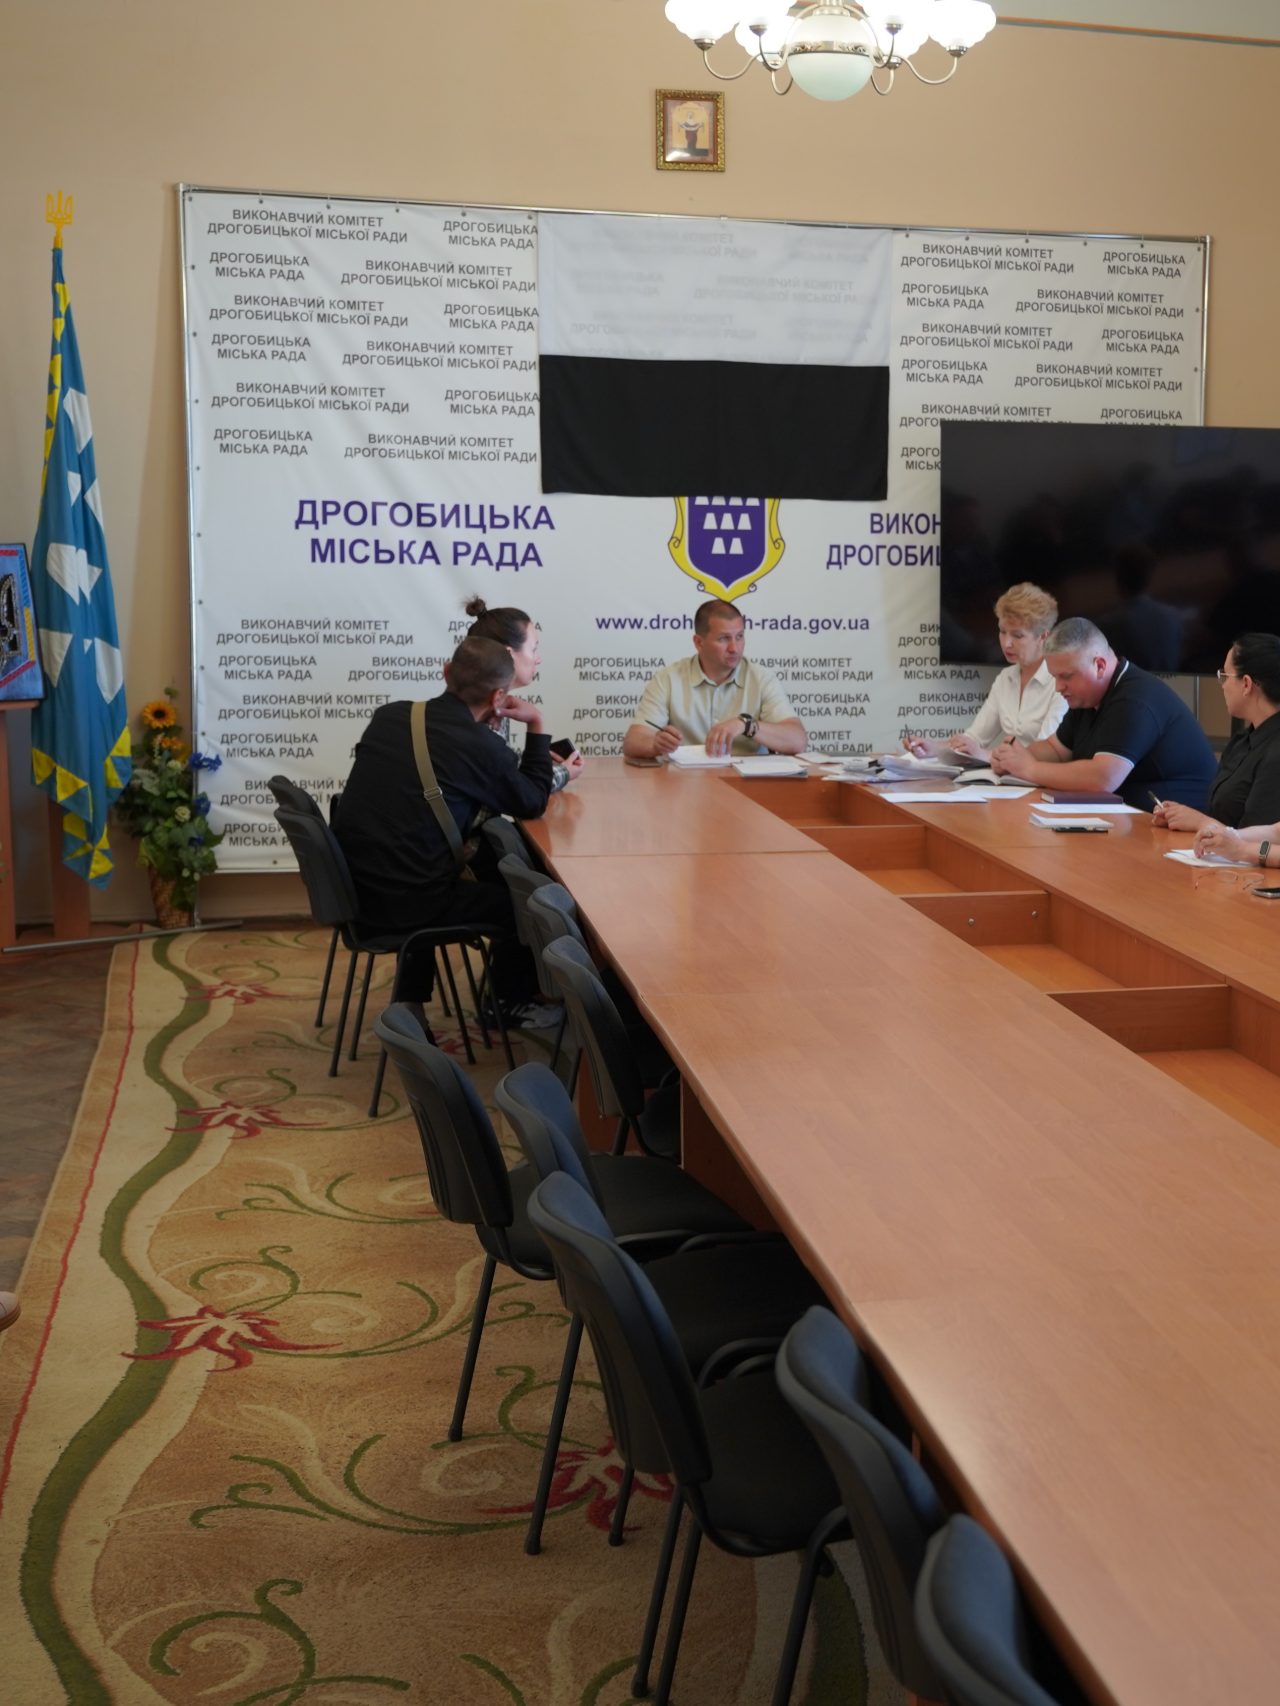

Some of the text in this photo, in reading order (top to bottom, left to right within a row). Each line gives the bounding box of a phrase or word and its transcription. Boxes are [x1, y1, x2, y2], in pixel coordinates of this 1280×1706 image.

[232, 209, 383, 228] ВИКОНАВЧИЙ КОМІТЕТ
[207, 222, 407, 244] ДРОГОБИЦЬКОЇ МІСЬКОЇ РАДИ
[443, 220, 539, 235] ДРОГОБИЦЬКА
[448, 235, 534, 249] МІСЬКА РАДА
[922, 243, 1053, 259] ВИКОНАВЧИЙ КОМІТЕТ
[1102, 251, 1186, 265] ДРОГОБИЦЬКА
[209, 252, 310, 266] ДРОГОБИЦЬКА
[900, 256, 1074, 275] ДРОГОБИЦЬКОЇ МІСЬКОЇ РАДИ
[215, 266, 305, 281] МІСЬКА РАДА
[365, 260, 512, 277] ВИКОНАВЧИЙ КОМІТЕТ
[1107, 264, 1182, 279] МІСЬКА РАДА
[340, 273, 536, 292] ДРОГОБИЦЬКОЇ МІСЬКОЇ РАДИ
[901, 283, 989, 297] ДРОГОБИЦЬКА
[1037, 289, 1164, 304] ВИКОНАВЧИЙ КОМІТЕТ
[234, 295, 384, 311] ВИКОНАВЧИЙ КОМІТЕТ
[907, 296, 984, 310] МІСЬКА РАДА
[1015, 301, 1184, 319] ДРОГОБИЦЬКОЇ МІСЬКОЇ РАДИ
[443, 303, 540, 318] ДРОГОБИЦЬКА
[209, 308, 408, 328] ДРОГОБИЦЬКОЇ МІСЬКОЇ РАДИ
[449, 318, 535, 332] МІСЬКА РАДА
[922, 323, 1053, 338] ВИКОНАВЧИЙ КОМІТЕТ
[1101, 329, 1184, 342] ДРОГОБИЦЬКА
[211, 334, 311, 347] ДРОГОБИЦЬКА
[899, 335, 1073, 353] ДРОГОБИЦЬКОЇ МІСЬКОЇ РАДИ
[217, 348, 306, 362] МІСЬКА РАДА
[366, 340, 513, 357] ВИКОНАВЧИЙ КОМІТЕТ
[1106, 342, 1180, 355] МІСЬКА РАДА
[342, 353, 537, 372] ДРОГОБИЦЬКОЇ МІСЬКОЇ РАДИ
[901, 359, 988, 372] ДРОГОБИЦЬКА
[1036, 363, 1163, 378] ВИКОНАВЧИЙ КОМІТЕТ
[906, 372, 984, 385] МІСЬКА РАДА
[1014, 376, 1183, 392] ДРОГОБИЦЬКОЇ МІСЬКОЇ РАДИ
[236, 382, 385, 398] ВИКОНАВЧИЙ КОМІТЕТ
[444, 389, 541, 402] ДРОГОБИЦЬКА
[211, 396, 409, 414] ДРОГОБИЦЬКОЇ МІСЬКОЇ РАДИ
[450, 403, 535, 417] МІСЬКА РАДА
[921, 404, 1052, 417] ВИКОНАВЧИЙ КОМІТЕТ
[1100, 408, 1183, 421] ДРОГОБИЦЬКА
[213, 428, 313, 442] ДРОГОБИЦЬКА
[368, 433, 514, 449] ВИКОНАВЧИЙ КОМІТЕТ
[219, 443, 308, 457] МІСЬКА РАДА
[344, 447, 537, 464] ДРОГОБИЦЬКОЇ МІСЬКОЇ РАДИ
[905, 460, 942, 471] МІСЬК
[295, 500, 555, 532] ДРОГОБИЦЬКА
[869, 512, 942, 535] ВИКОН
[310, 537, 544, 573] МІСЬКА РАДА
[826, 543, 942, 571] ДРОГОБИ
[241, 618, 390, 631] ВИКОНАВЧИЙ КОМІТЕТ
[595, 613, 870, 635] www.drohh-rada.gov.ua
[216, 633, 414, 647] ДРОГОБИЦЬКОЇ МІСЬКОЇ РАДИ
[218, 655, 317, 667] ДРОГОБИЦЬКА
[573, 657, 666, 669] ДРОГОБИЦЬКА
[802, 658, 853, 669] КОМІТЕТ
[224, 669, 313, 682] МІСЬКА РАДА
[348, 670, 446, 683] ДРОГОБИЦЬКО
[579, 670, 654, 683] МІСЬКА РАД
[791, 670, 839, 682] МІСЬКОЇ
[842, 671, 874, 683] РАДИ
[904, 669, 981, 682] МІСЬКА РАДА
[242, 693, 391, 706] ВИКОНАВЧИЙ КОМІТЕТ
[218, 707, 374, 721] ДРОГОБИЦЬКОЇ МІСЬКО
[794, 706, 867, 717] ІСЬКА РАДА
[220, 733, 319, 745] ДРОГОБИЦЬКА
[574, 732, 625, 744] ДРОГОБ
[806, 730, 851, 742] ОМІТЕТ
[226, 747, 315, 759] МІСЬКА РАДА
[229, 836, 278, 848] МІСЬКА
